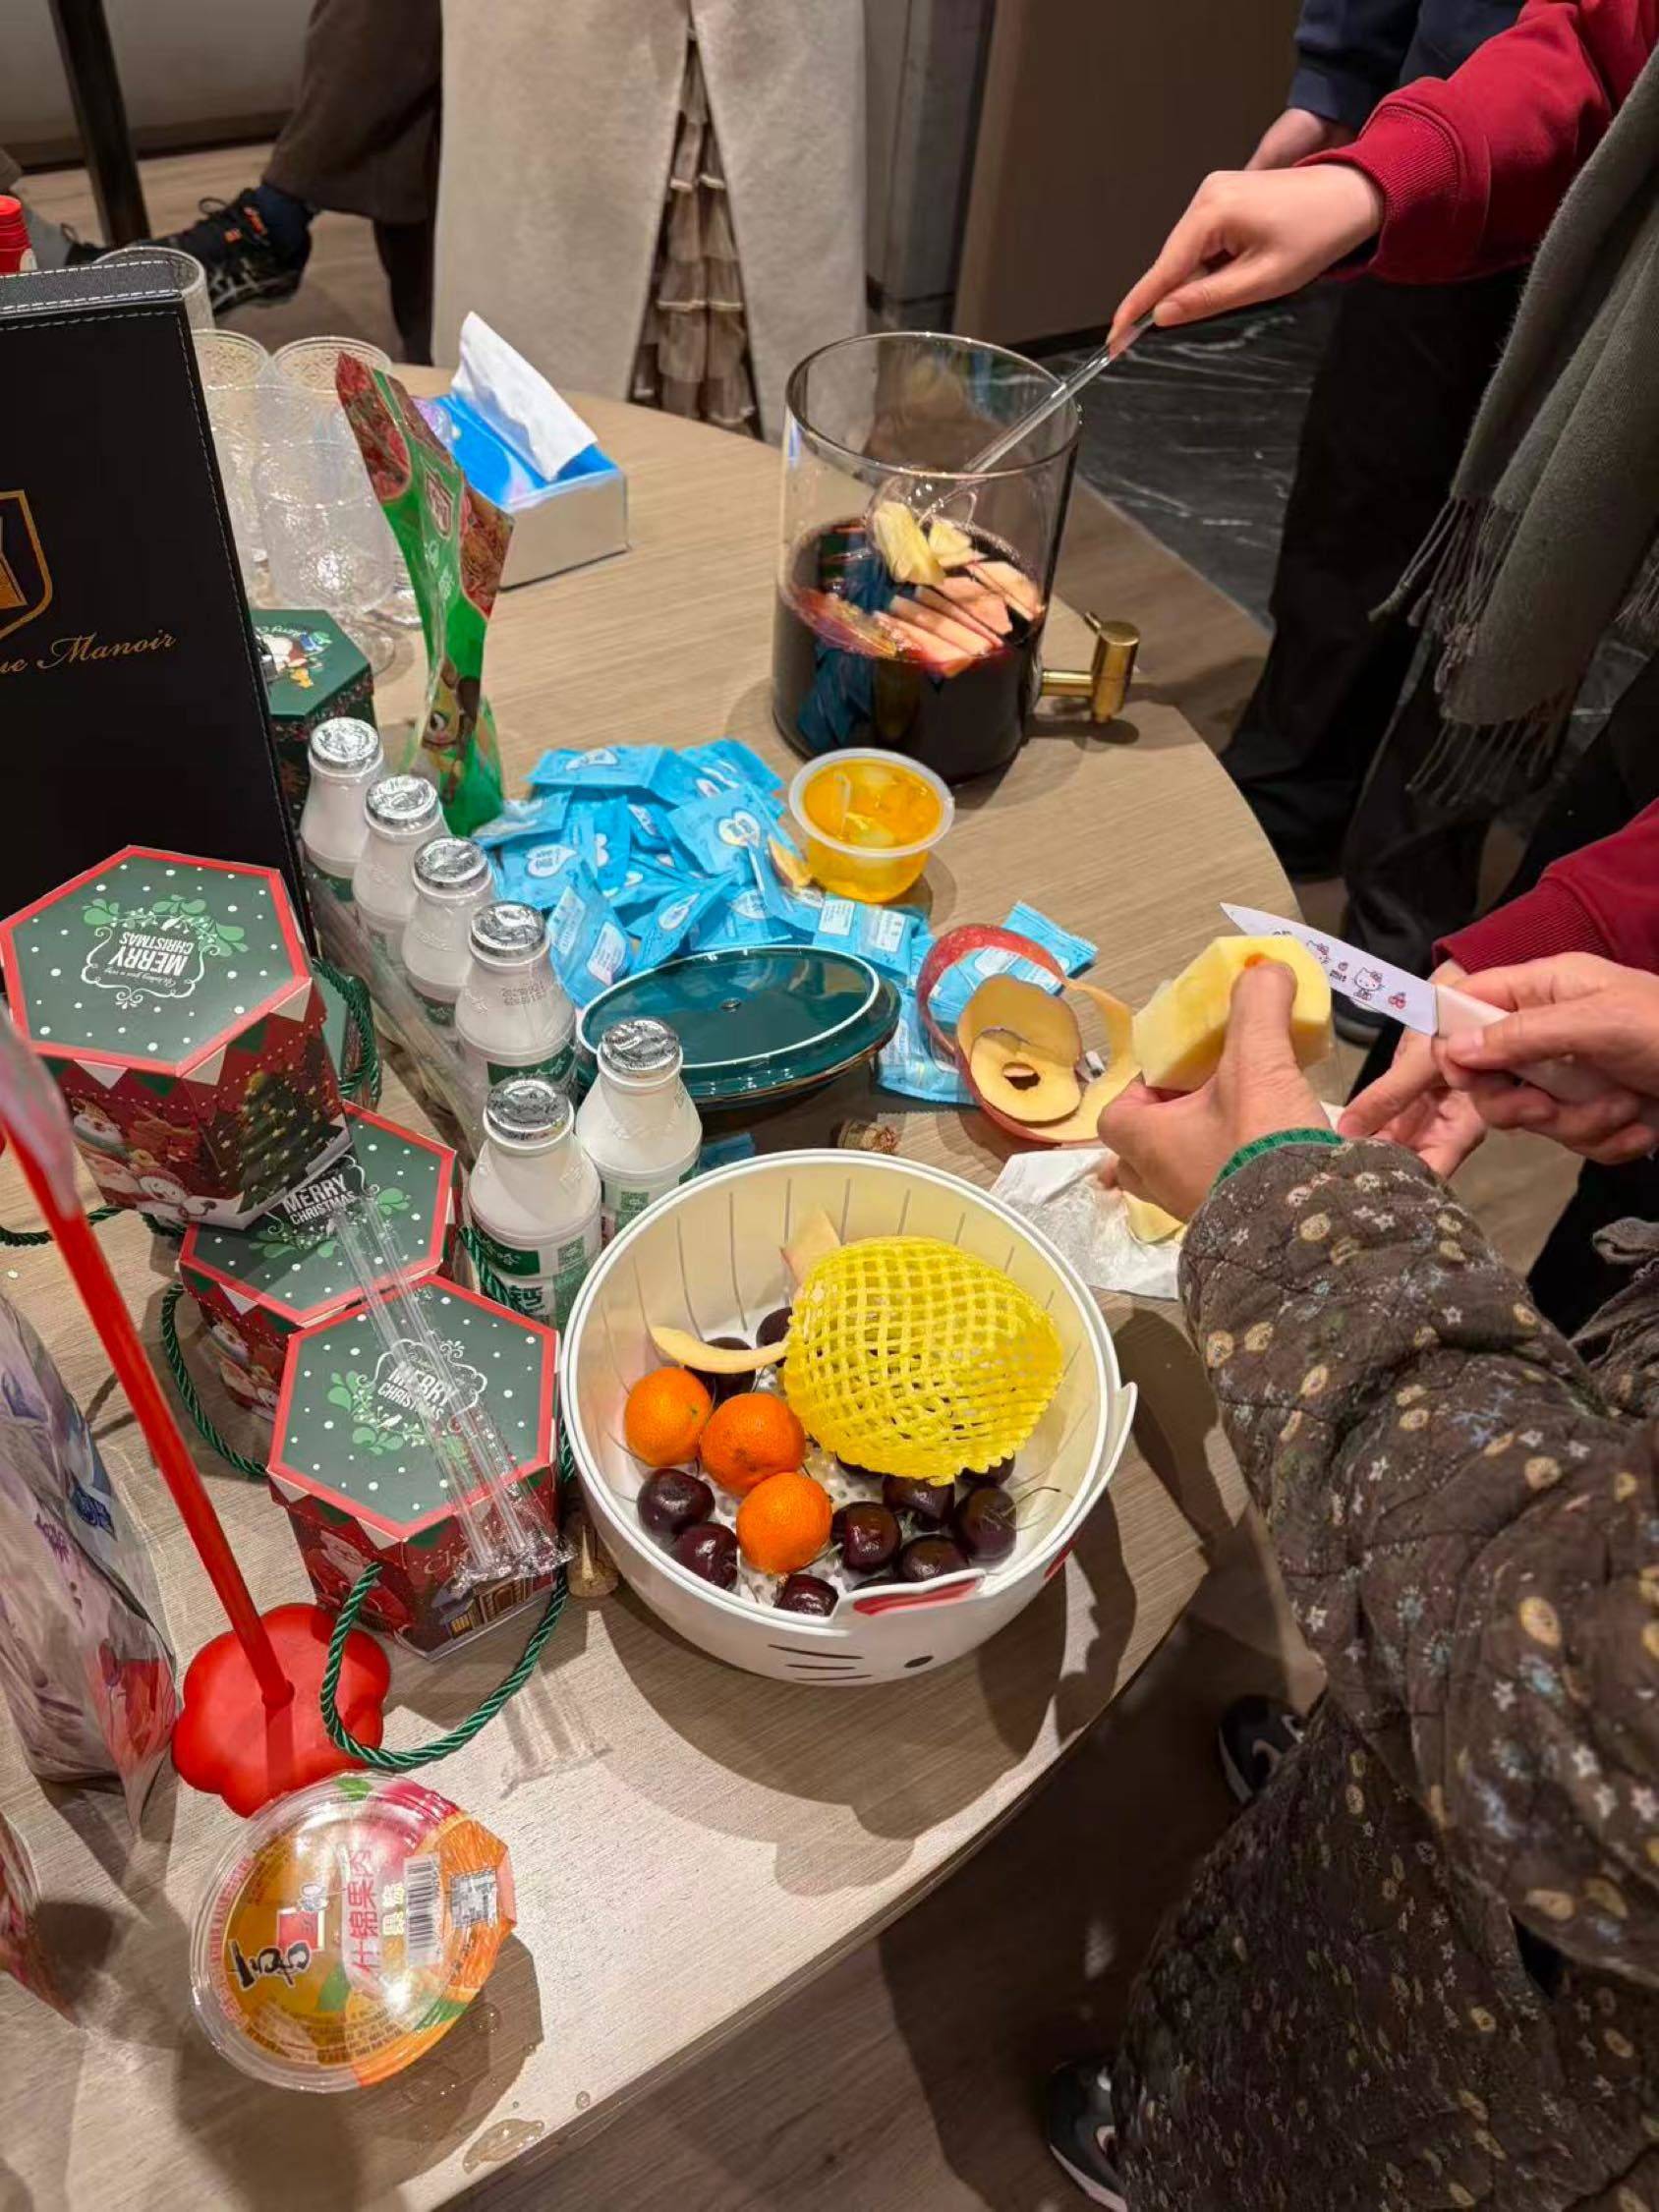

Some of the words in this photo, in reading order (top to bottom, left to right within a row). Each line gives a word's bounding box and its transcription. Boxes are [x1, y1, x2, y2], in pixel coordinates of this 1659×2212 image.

[36, 629, 177, 669] Manoir
[107, 945, 189, 976] MERRY
[119, 932, 195, 954] CHRISTMAS
[283, 1173, 347, 1215] MERRY
[348, 1849, 380, 1972] 什锦果肉
